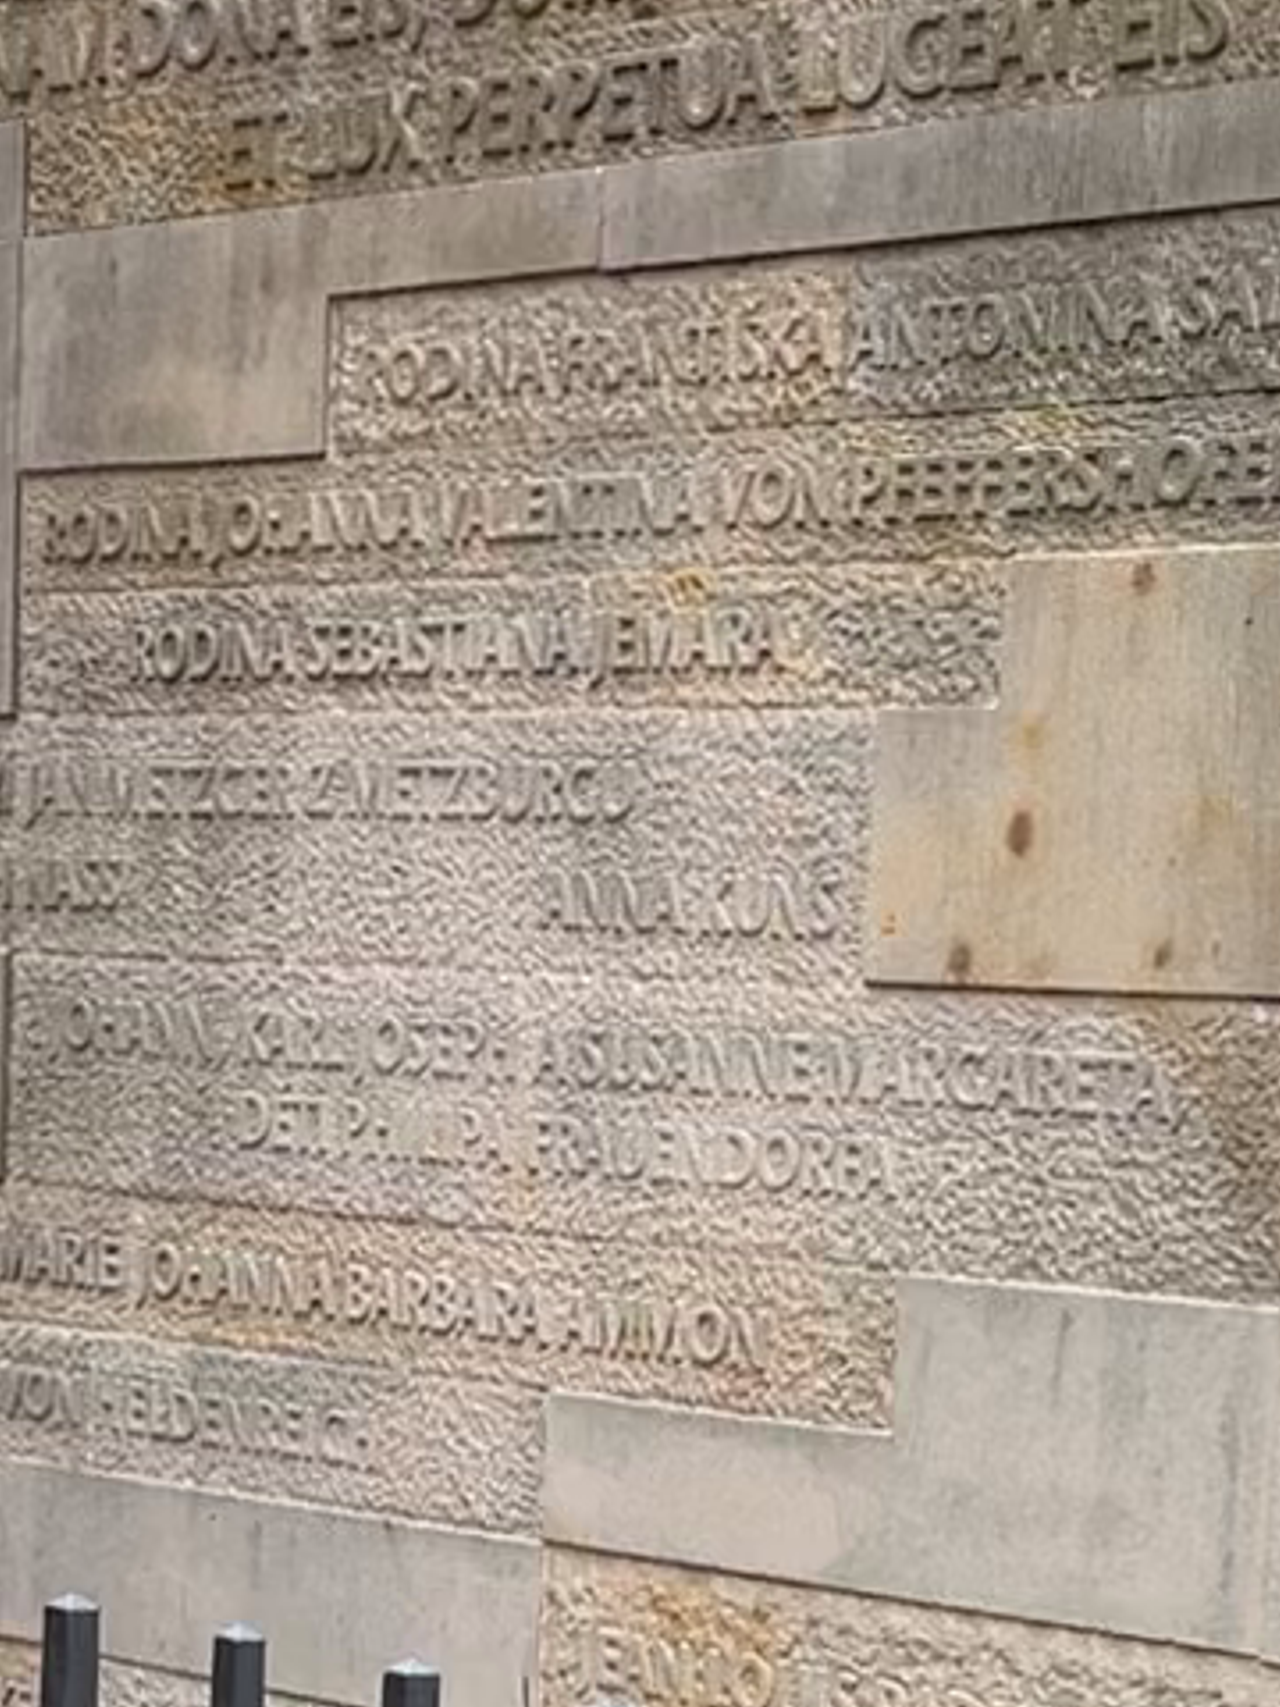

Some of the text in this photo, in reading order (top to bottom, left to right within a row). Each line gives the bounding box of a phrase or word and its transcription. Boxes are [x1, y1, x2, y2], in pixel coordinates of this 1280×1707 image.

[221, 111, 292, 190] ET
[308, 86, 424, 180] LUX
[436, 35, 780, 165] PERPETUA
[40, 487, 203, 565] RODINA
[442, 471, 703, 547] VALENTINA
[723, 441, 828, 531] VON
[133, 609, 580, 687] RODINA SEBASTIANA
[136, 1239, 336, 1321] JOHANNA
[346, 1261, 548, 1351] BARBARA
